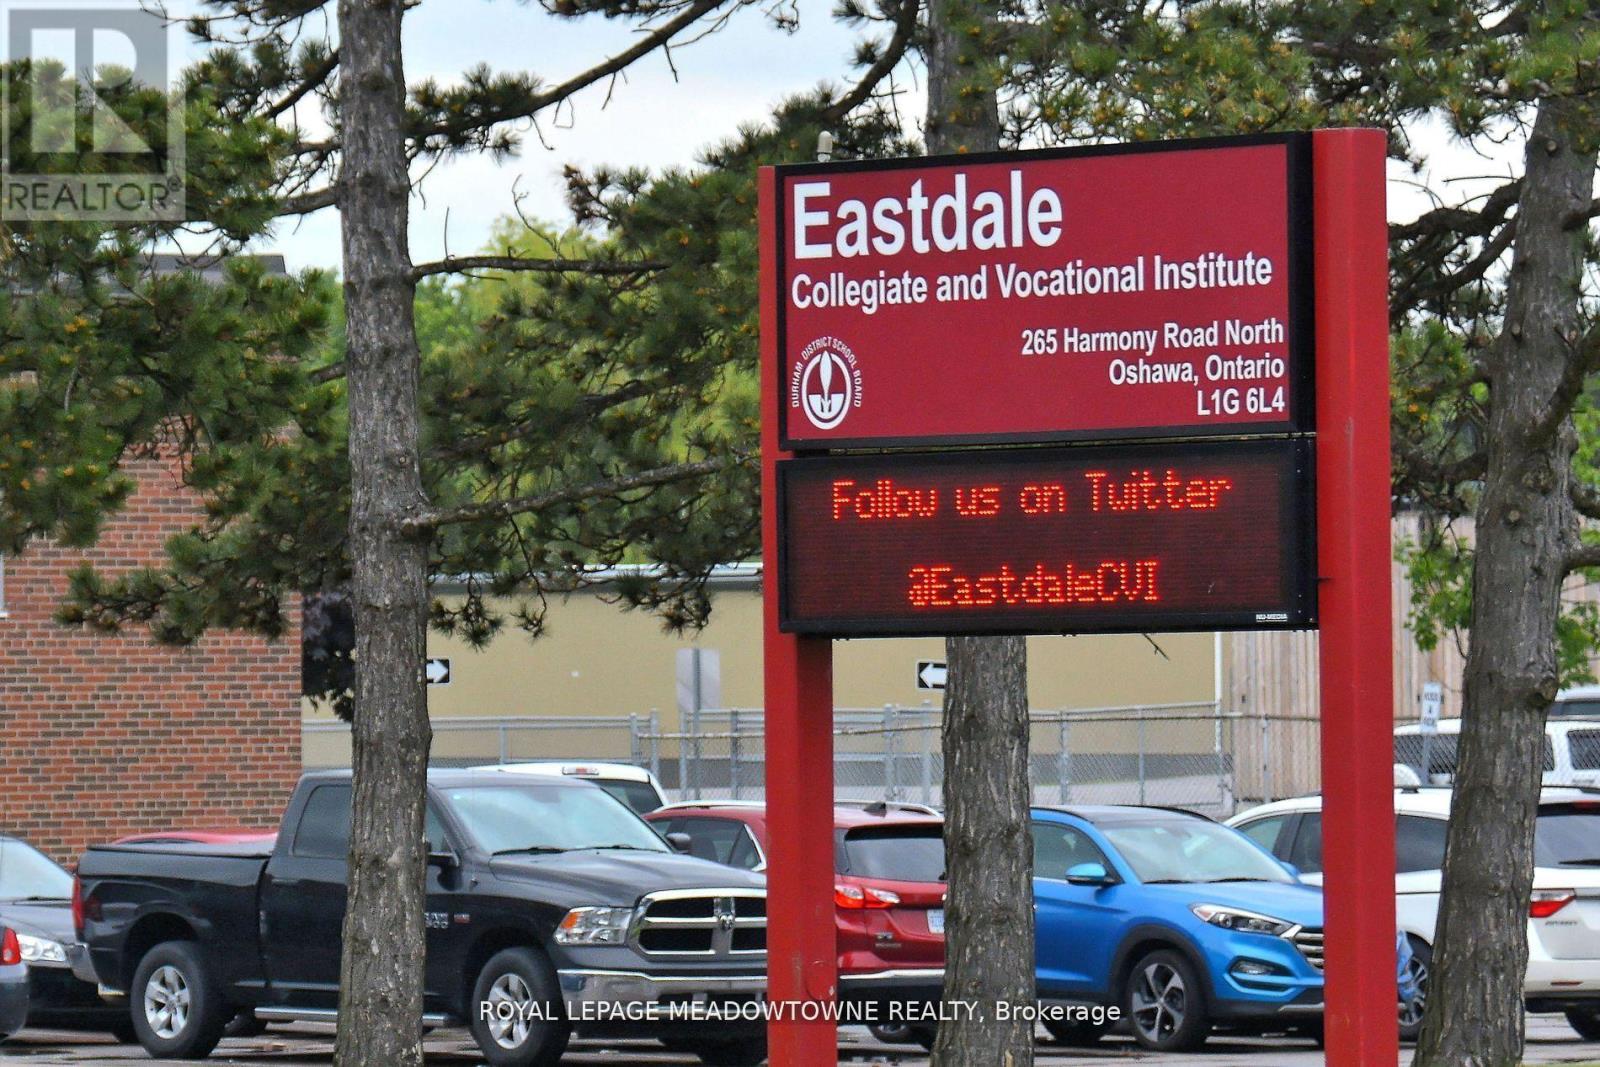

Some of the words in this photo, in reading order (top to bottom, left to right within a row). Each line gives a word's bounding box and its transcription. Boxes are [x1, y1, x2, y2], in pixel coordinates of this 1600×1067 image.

[793, 170, 1063, 260] Eastdale
[791, 269, 928, 315] Collegiate
[935, 264, 988, 303] and
[995, 256, 1145, 299] Vocational
[1153, 251, 1273, 291] Institute
[1021, 328, 1058, 356] 265
[1063, 328, 1158, 356] Harmony
[1164, 320, 1218, 349] Road
[1225, 317, 1284, 346] North
[791, 361, 804, 408] DURHAM
[801, 336, 832, 361] DISTRICT
[832, 338, 858, 369] SCHOOL
[852, 369, 863, 408] BOARD
[1109, 358, 1199, 386] Oshawa,
[1205, 353, 1285, 381] Ontario
[1197, 388, 1239, 416] L1G
[1246, 386, 1285, 414] 6L4
[832, 479, 938, 520] Follow
[955, 487, 1000, 516] us
[1019, 485, 1065, 514] on
[1084, 470, 1233, 512] Twitter
[907, 560, 1159, 606] @EastdaleCVI
